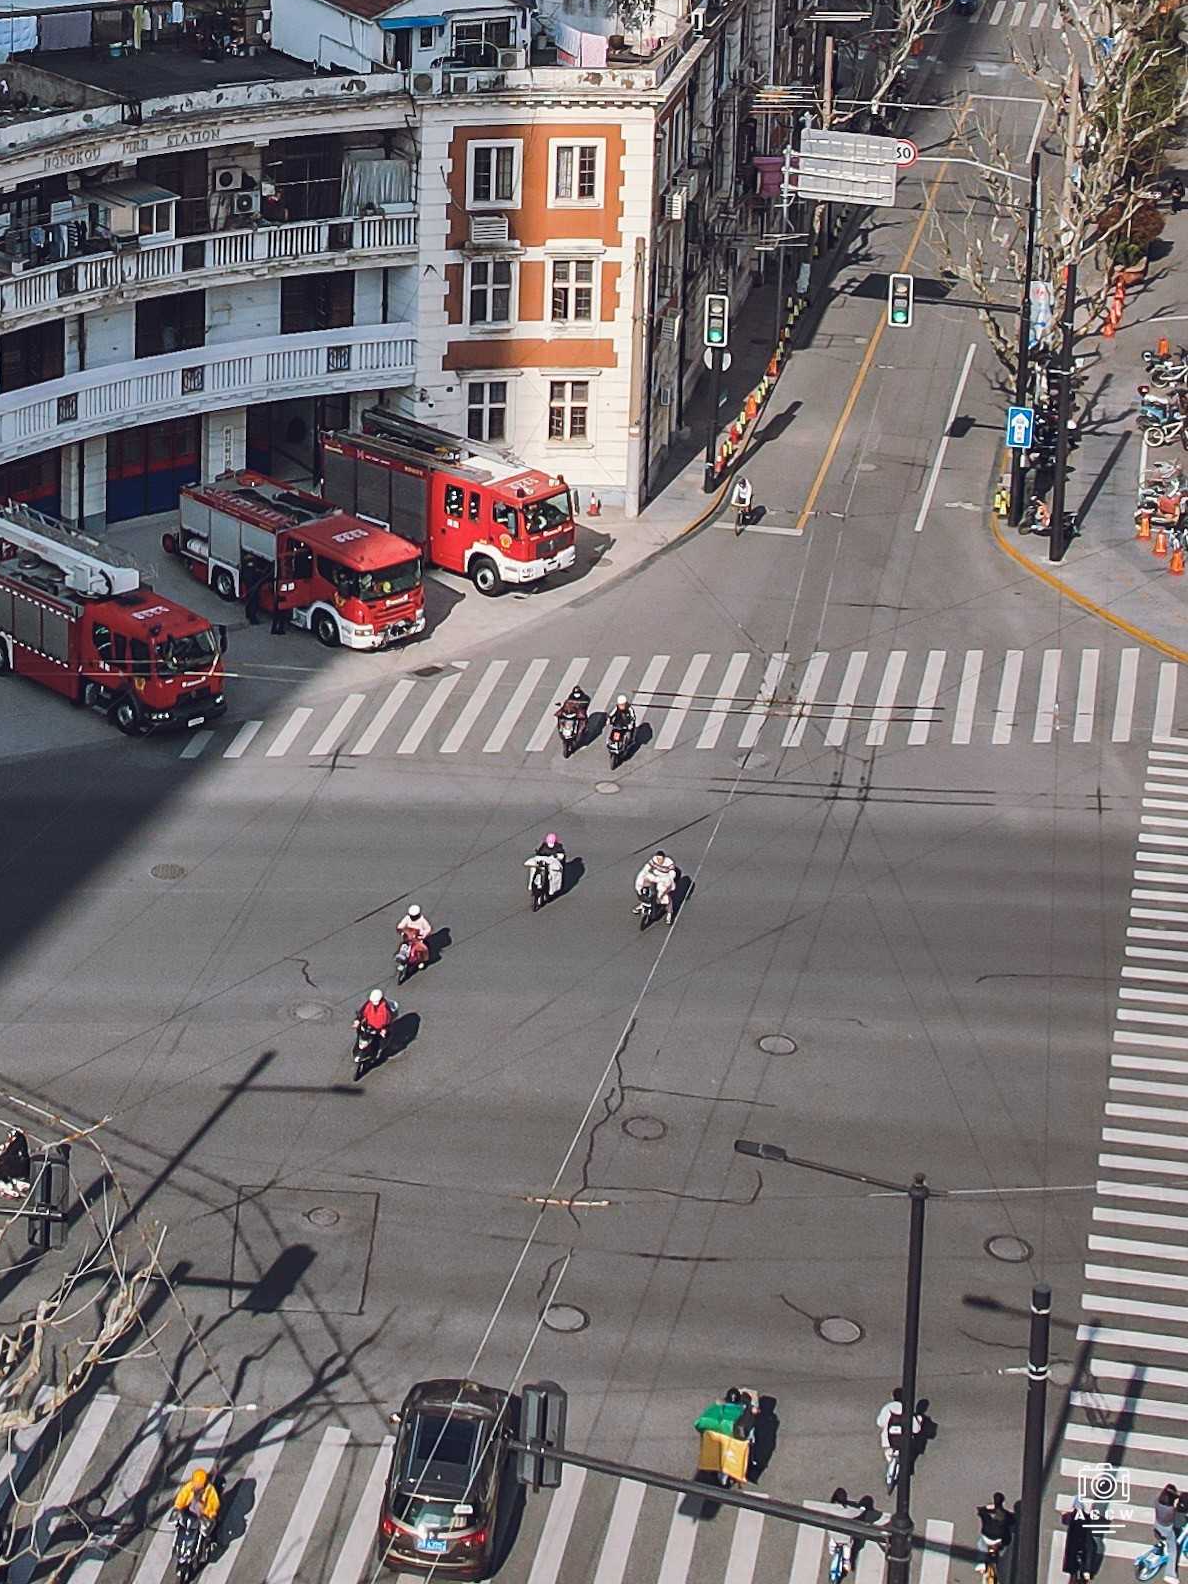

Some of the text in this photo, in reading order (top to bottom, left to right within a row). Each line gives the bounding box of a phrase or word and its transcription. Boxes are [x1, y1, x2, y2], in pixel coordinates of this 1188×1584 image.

[44, 148, 101, 170] HONGKOU
[167, 129, 220, 146] STATION
[896, 147, 911, 159] 50
